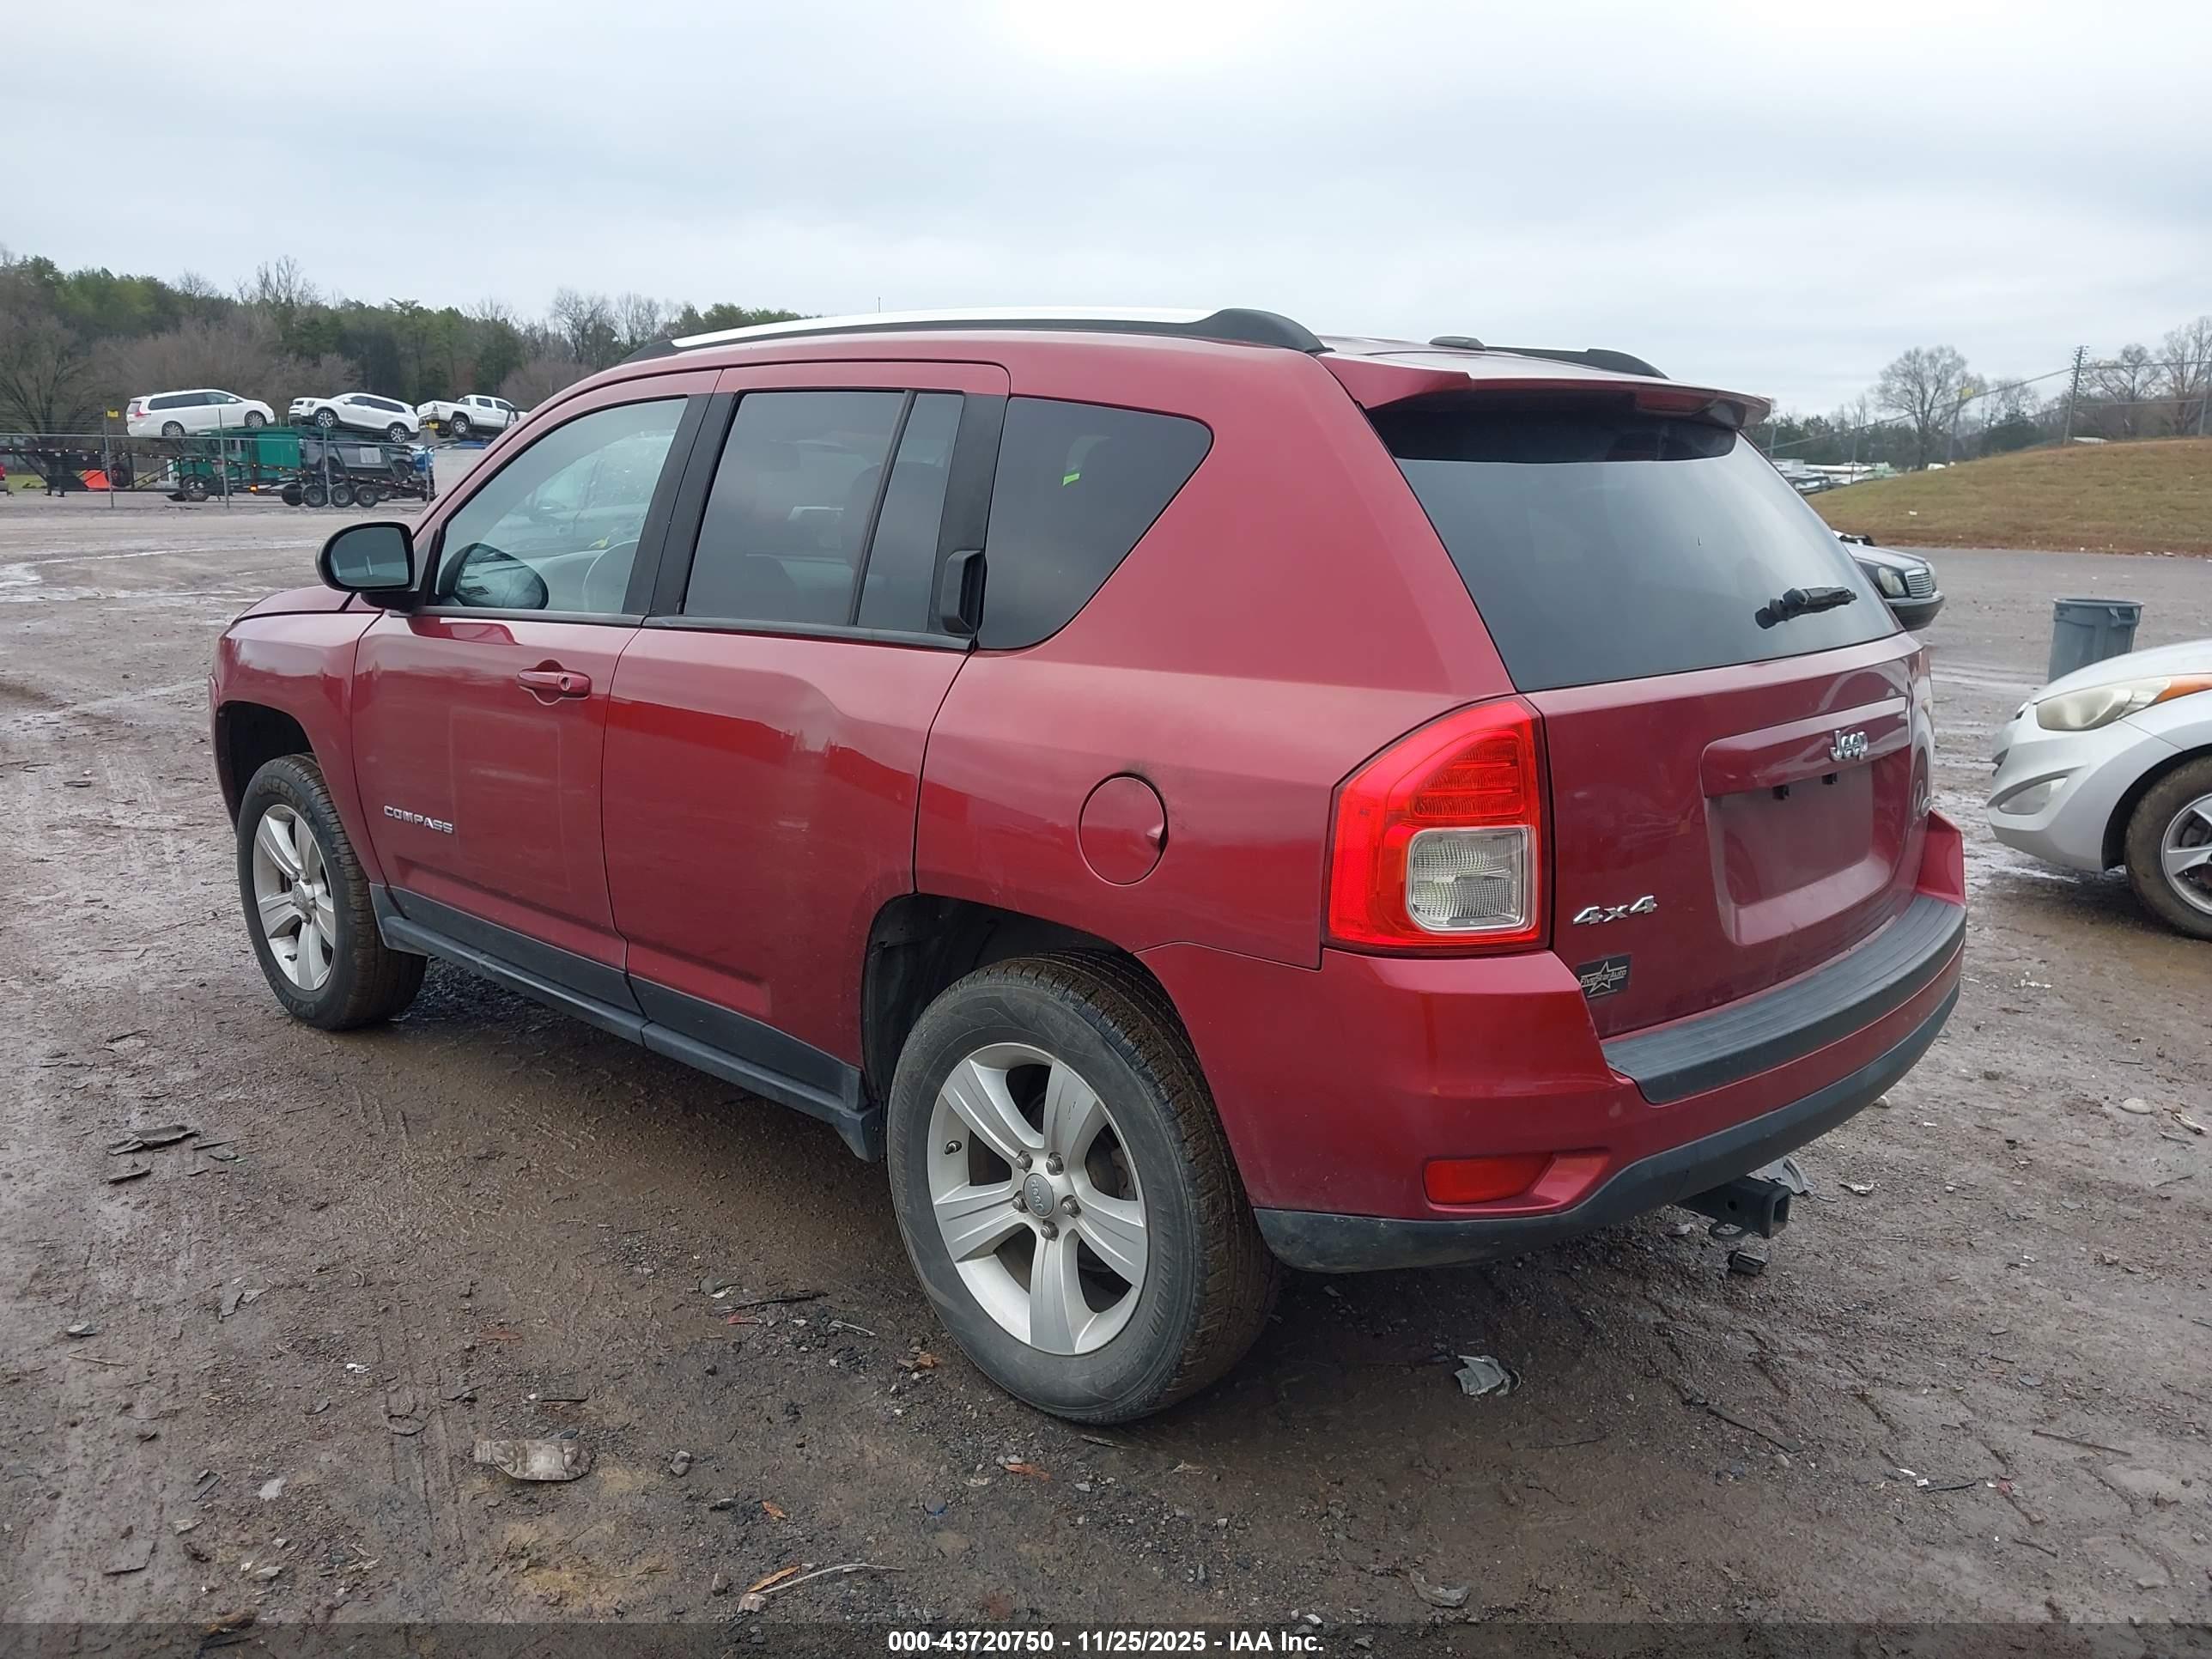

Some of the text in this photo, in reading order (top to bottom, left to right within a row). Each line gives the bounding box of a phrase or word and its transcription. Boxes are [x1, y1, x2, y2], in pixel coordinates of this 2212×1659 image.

[1829, 730, 1869, 762] Jeep
[383, 805, 453, 834] COMPASS
[1572, 895, 1658, 926] 4x4
